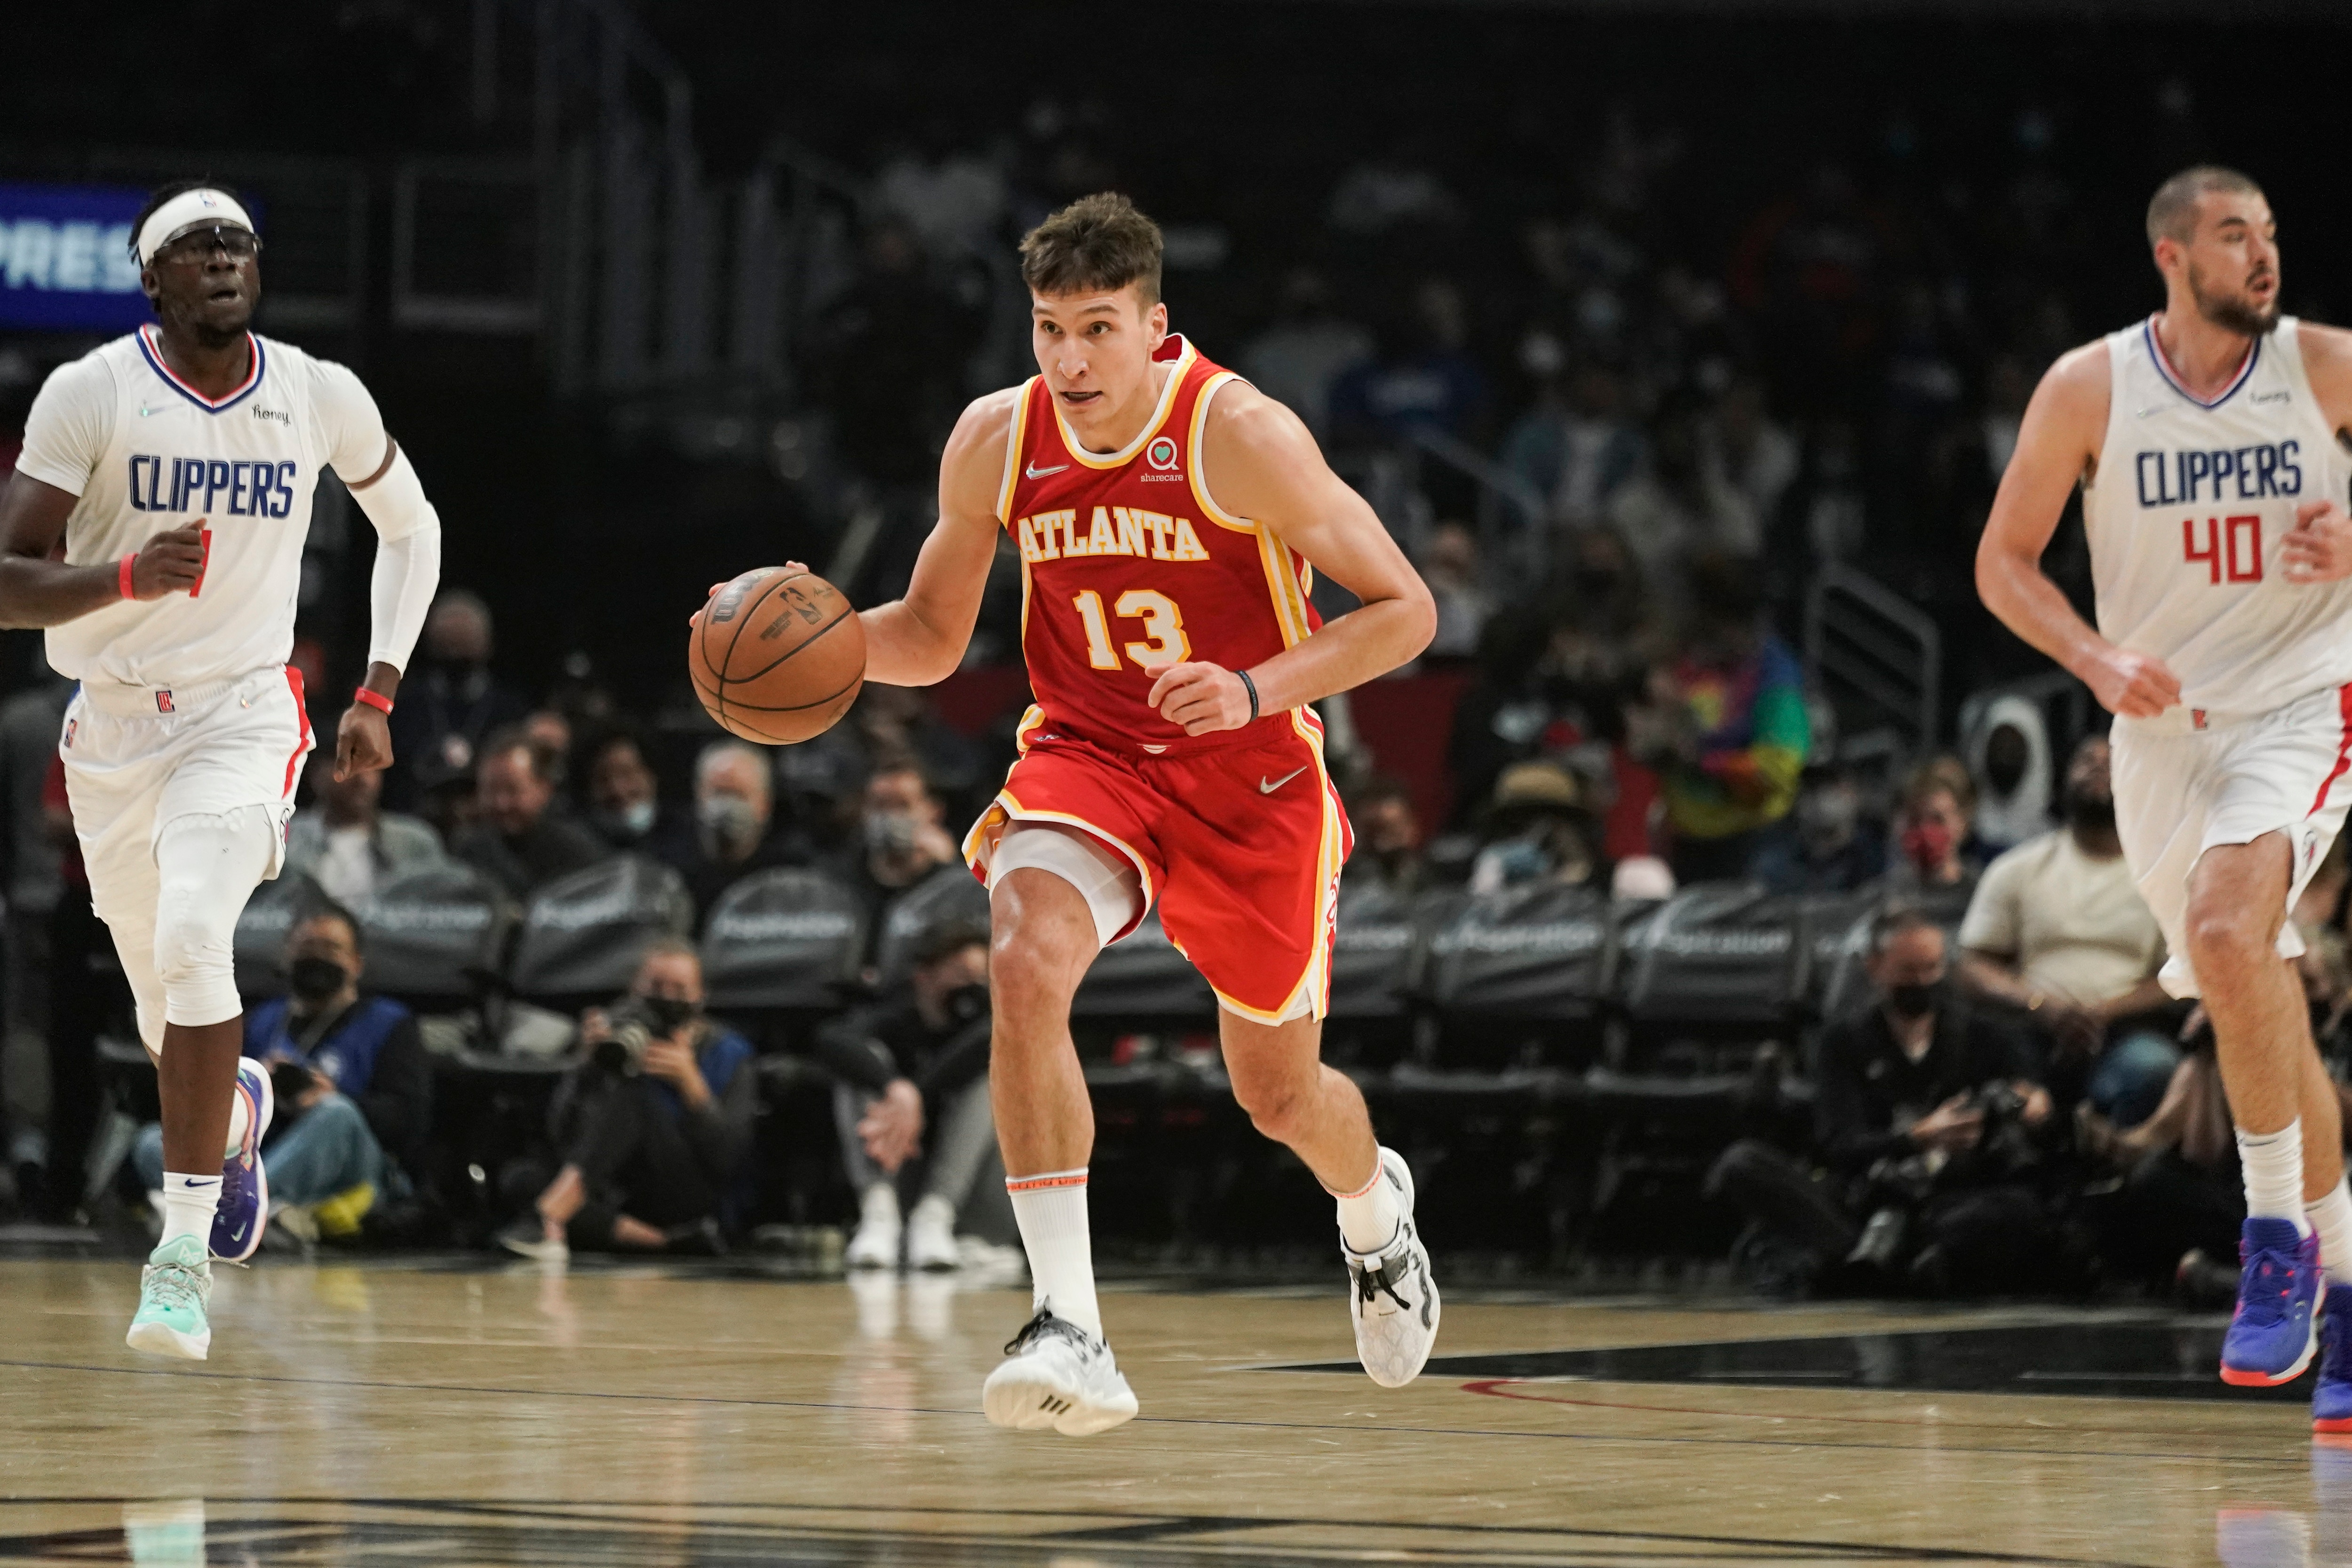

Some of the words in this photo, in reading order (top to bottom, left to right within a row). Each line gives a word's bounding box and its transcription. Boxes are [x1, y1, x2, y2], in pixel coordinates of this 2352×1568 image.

[252, 404, 291, 428] honey
[129, 455, 295, 519] CLIPPERS
[1141, 473, 1183, 482] sharecare
[2136, 440, 2301, 509] CLIPPERS
[1018, 506, 1210, 563] ATLANTA
[2183, 516, 2263, 586] 40
[1073, 589, 1192, 670] 13
